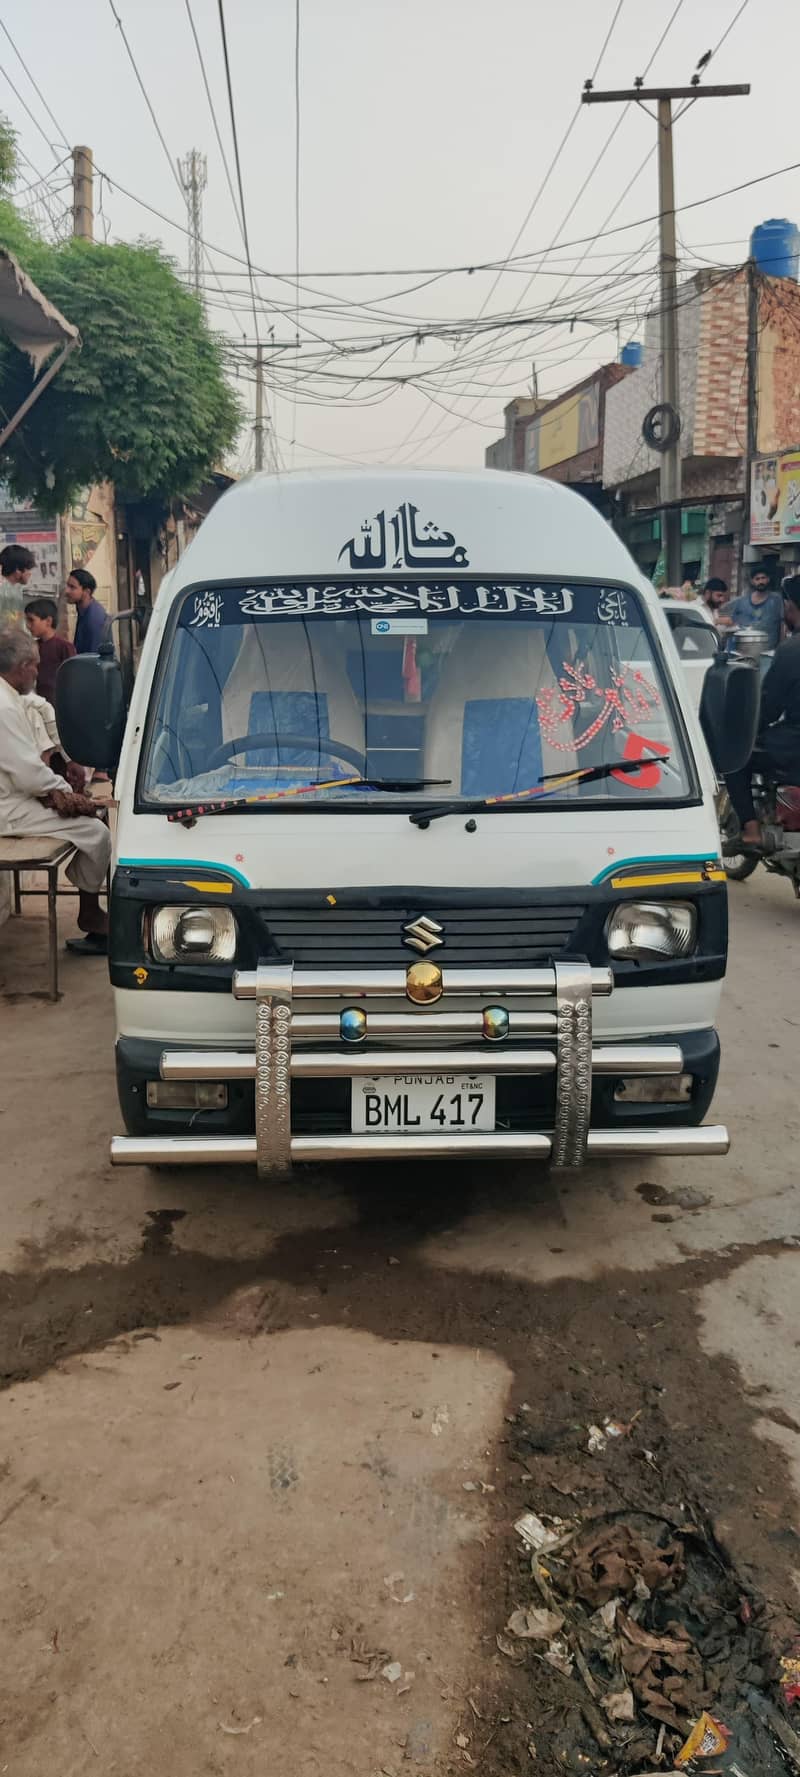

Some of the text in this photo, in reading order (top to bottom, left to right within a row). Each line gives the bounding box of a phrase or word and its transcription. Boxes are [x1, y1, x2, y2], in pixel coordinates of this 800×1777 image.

[394, 1075, 455, 1085] PUNJAB
[365, 1093, 484, 1126] BML 417
